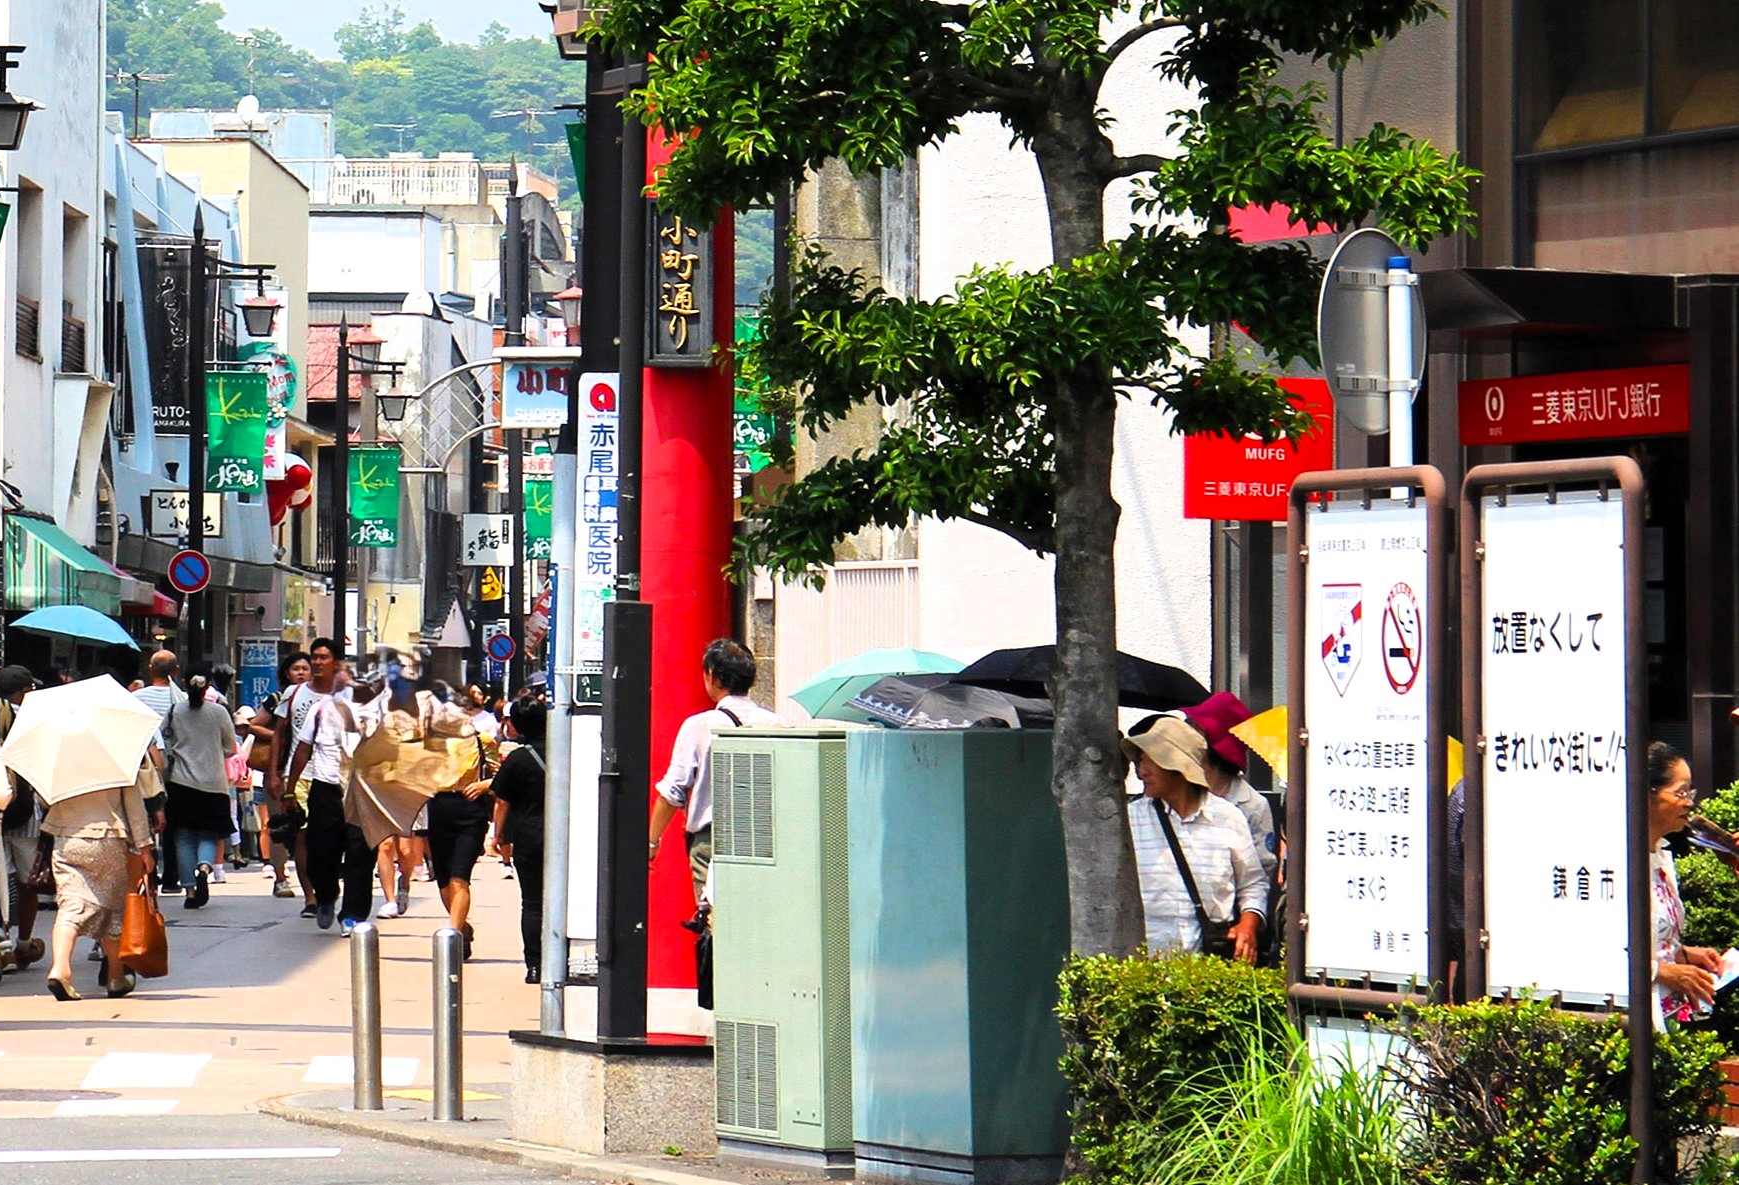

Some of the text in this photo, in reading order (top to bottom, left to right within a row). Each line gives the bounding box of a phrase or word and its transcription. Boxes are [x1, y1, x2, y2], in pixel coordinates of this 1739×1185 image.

[658, 216, 701, 351] 小町通り
[1531, 383, 1661, 425] 三菱東京UFJ銀行
[590, 423, 615, 473] 赤尾
[1246, 447, 1285, 461] MUFG
[158, 497, 192, 510] とんか
[1204, 481, 1324, 499] 三菱東京UF
[588, 526, 612, 575] 医院
[1492, 612, 1603, 654] 放置なくして
[1347, 876, 1387, 901] かまくら
[1552, 866, 1615, 901] 鎌倉市
